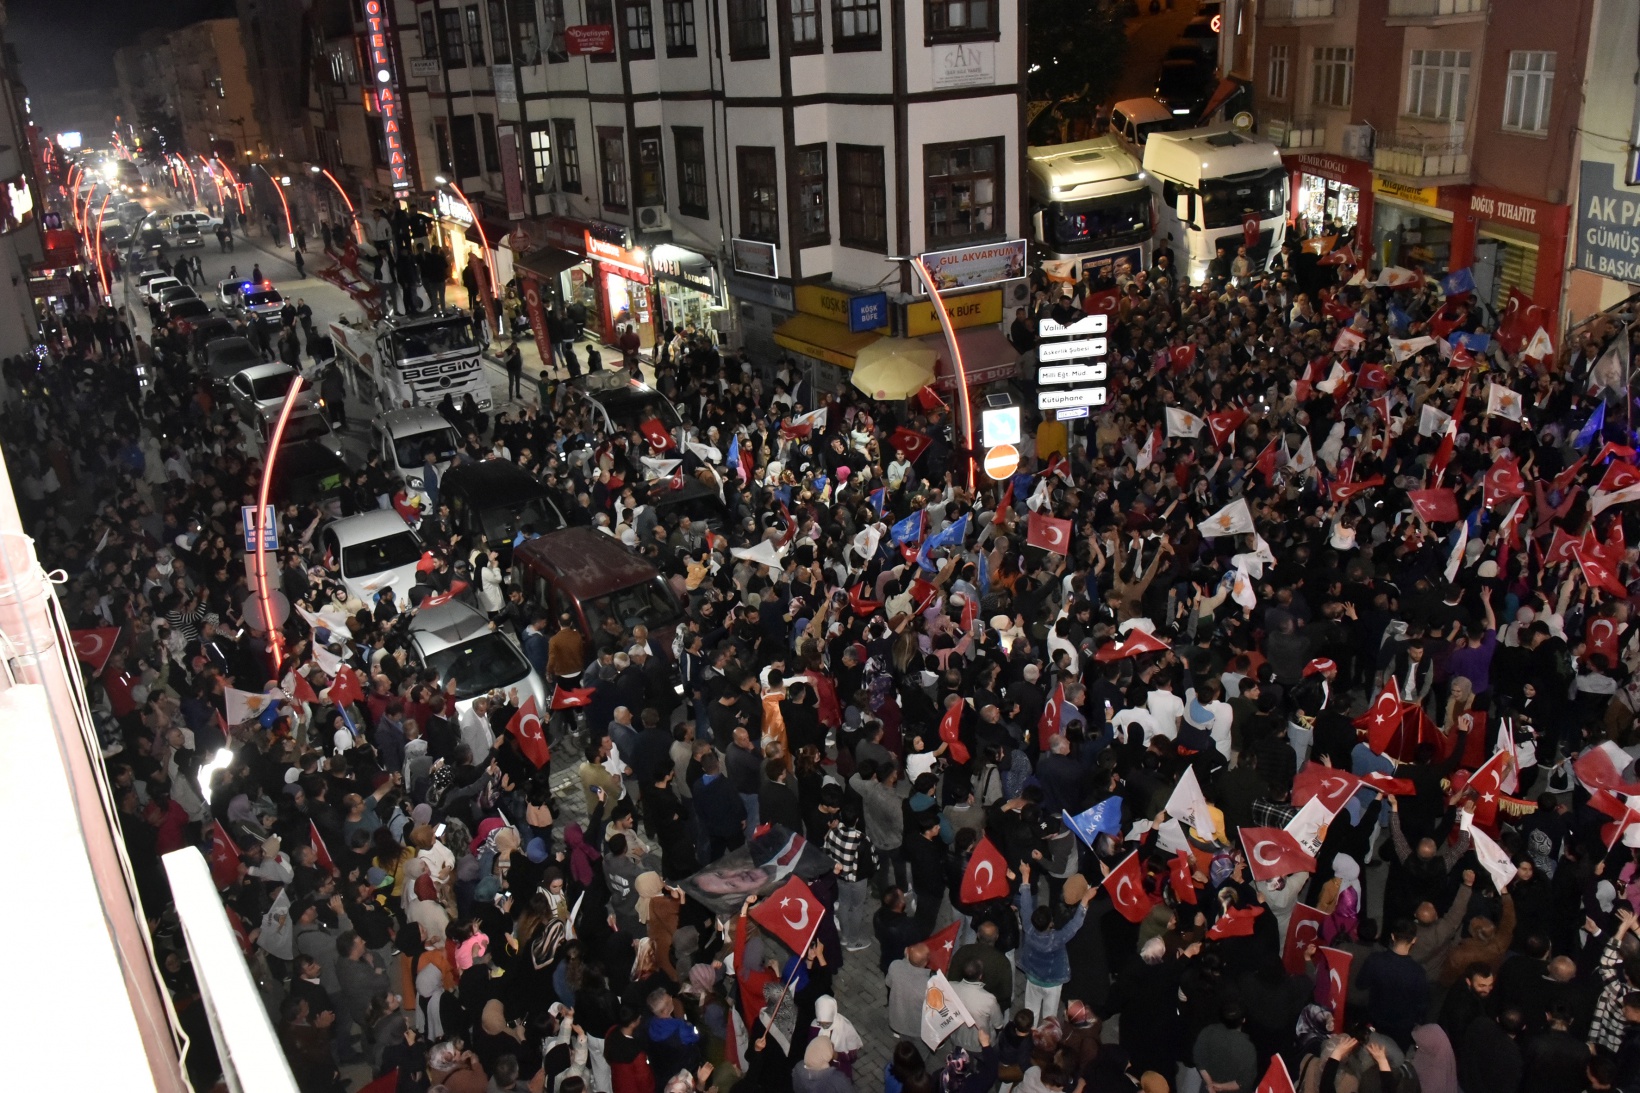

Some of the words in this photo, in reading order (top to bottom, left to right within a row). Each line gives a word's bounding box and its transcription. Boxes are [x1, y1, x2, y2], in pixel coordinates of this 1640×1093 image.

[366, 1, 387, 63] OTEL
[381, 88, 404, 179] ATALAY
[1471, 194, 1495, 219] DOĞUŞ
[1497, 201, 1537, 225] TUHAFİYE
[1588, 195, 1617, 223] AK
[1586, 226, 1640, 258] GÜMÜŞ
[939, 253, 959, 266] GÜL
[962, 246, 1014, 263] AKVARYUM
[1584, 249, 1596, 270] İL
[860, 304, 878, 314] KÖŞK
[956, 303, 981, 317] BÜFE
[861, 313, 878, 323] BÜFE
[1043, 348, 1068, 356] Askerlik
[1069, 346, 1090, 354] Şubesi
[1042, 394, 1084, 404] Kütüphane
[1085, 823, 1098, 836] AK
